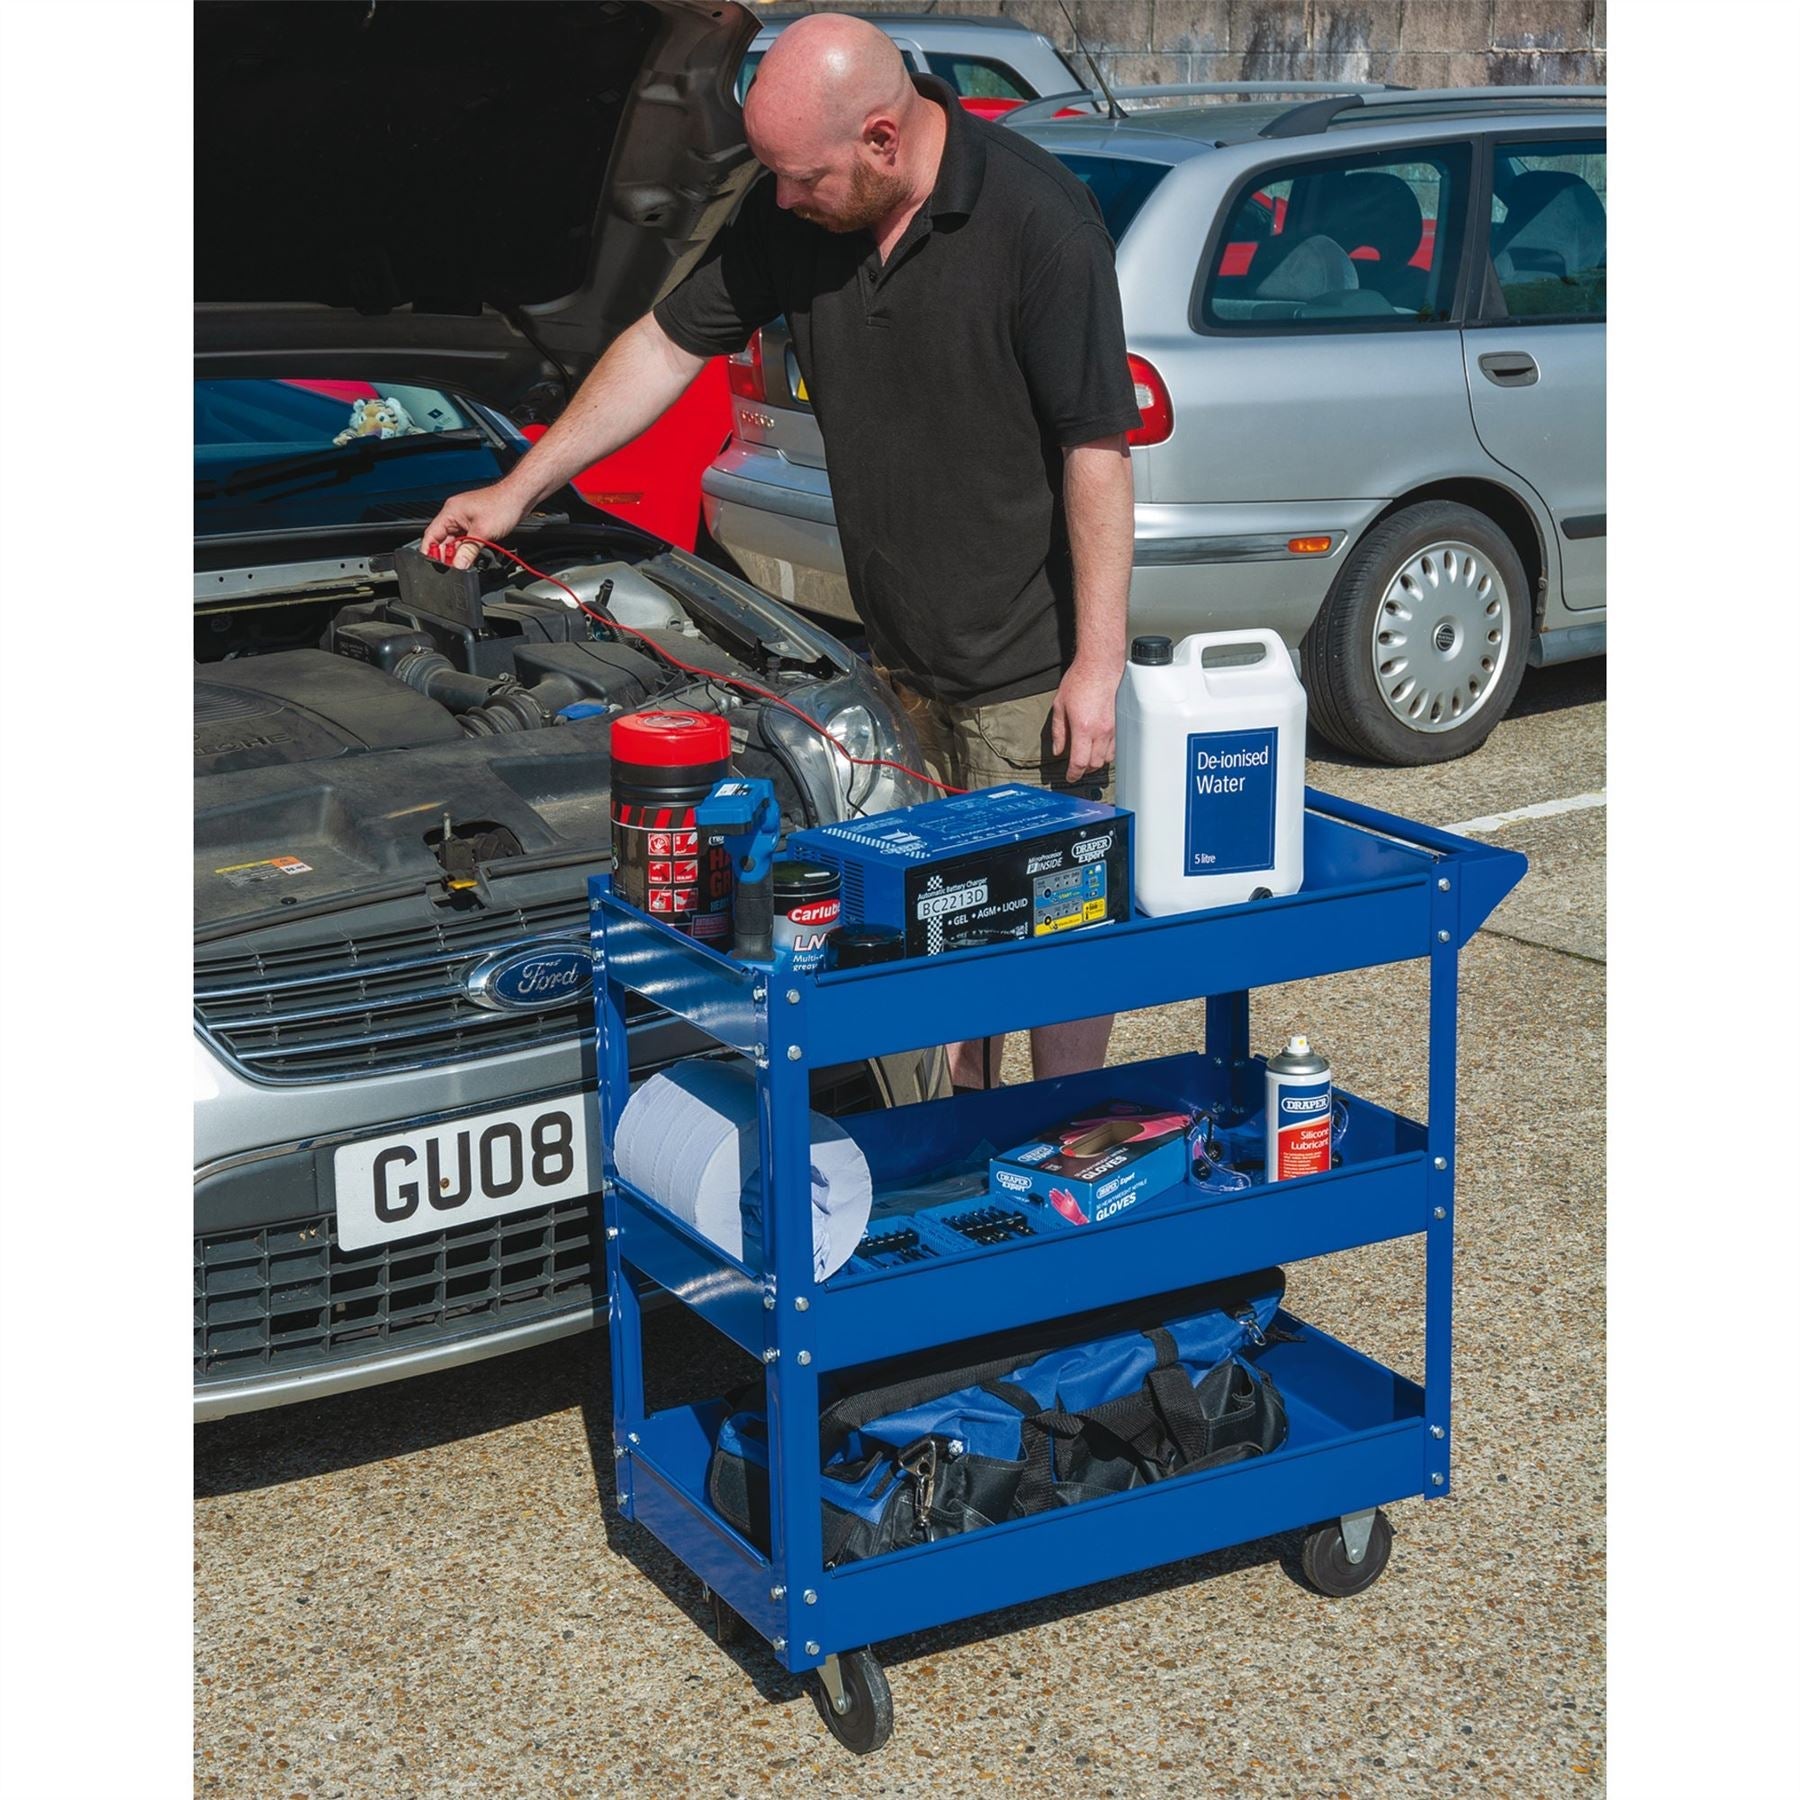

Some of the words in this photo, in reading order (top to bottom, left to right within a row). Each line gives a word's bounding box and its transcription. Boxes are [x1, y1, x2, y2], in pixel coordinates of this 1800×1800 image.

[1198, 745, 1268, 770] De-ionised
[1197, 775, 1245, 794] Water
[1075, 840, 1108, 855] DRAPER
[1078, 849, 1105, 863] Expert
[1194, 854, 1201, 864] 5
[1201, 853, 1216, 864] litre
[917, 887, 945, 901] Automatic
[946, 882, 966, 894] Battery
[966, 877, 988, 889] Charger
[923, 889, 984, 917] BC2213D
[953, 914, 968, 926] GEL
[977, 906, 996, 919] AGM
[1002, 898, 1028, 913] LIQUID
[518, 961, 578, 994] Ford
[1286, 1098, 1326, 1110] DRAPER
[373, 1111, 574, 1223] GU08
[1082, 1155, 1127, 1179] GLOVES
[1000, 1173, 1028, 1186] DRAPER
[1096, 1192, 1136, 1221] GLOVES
